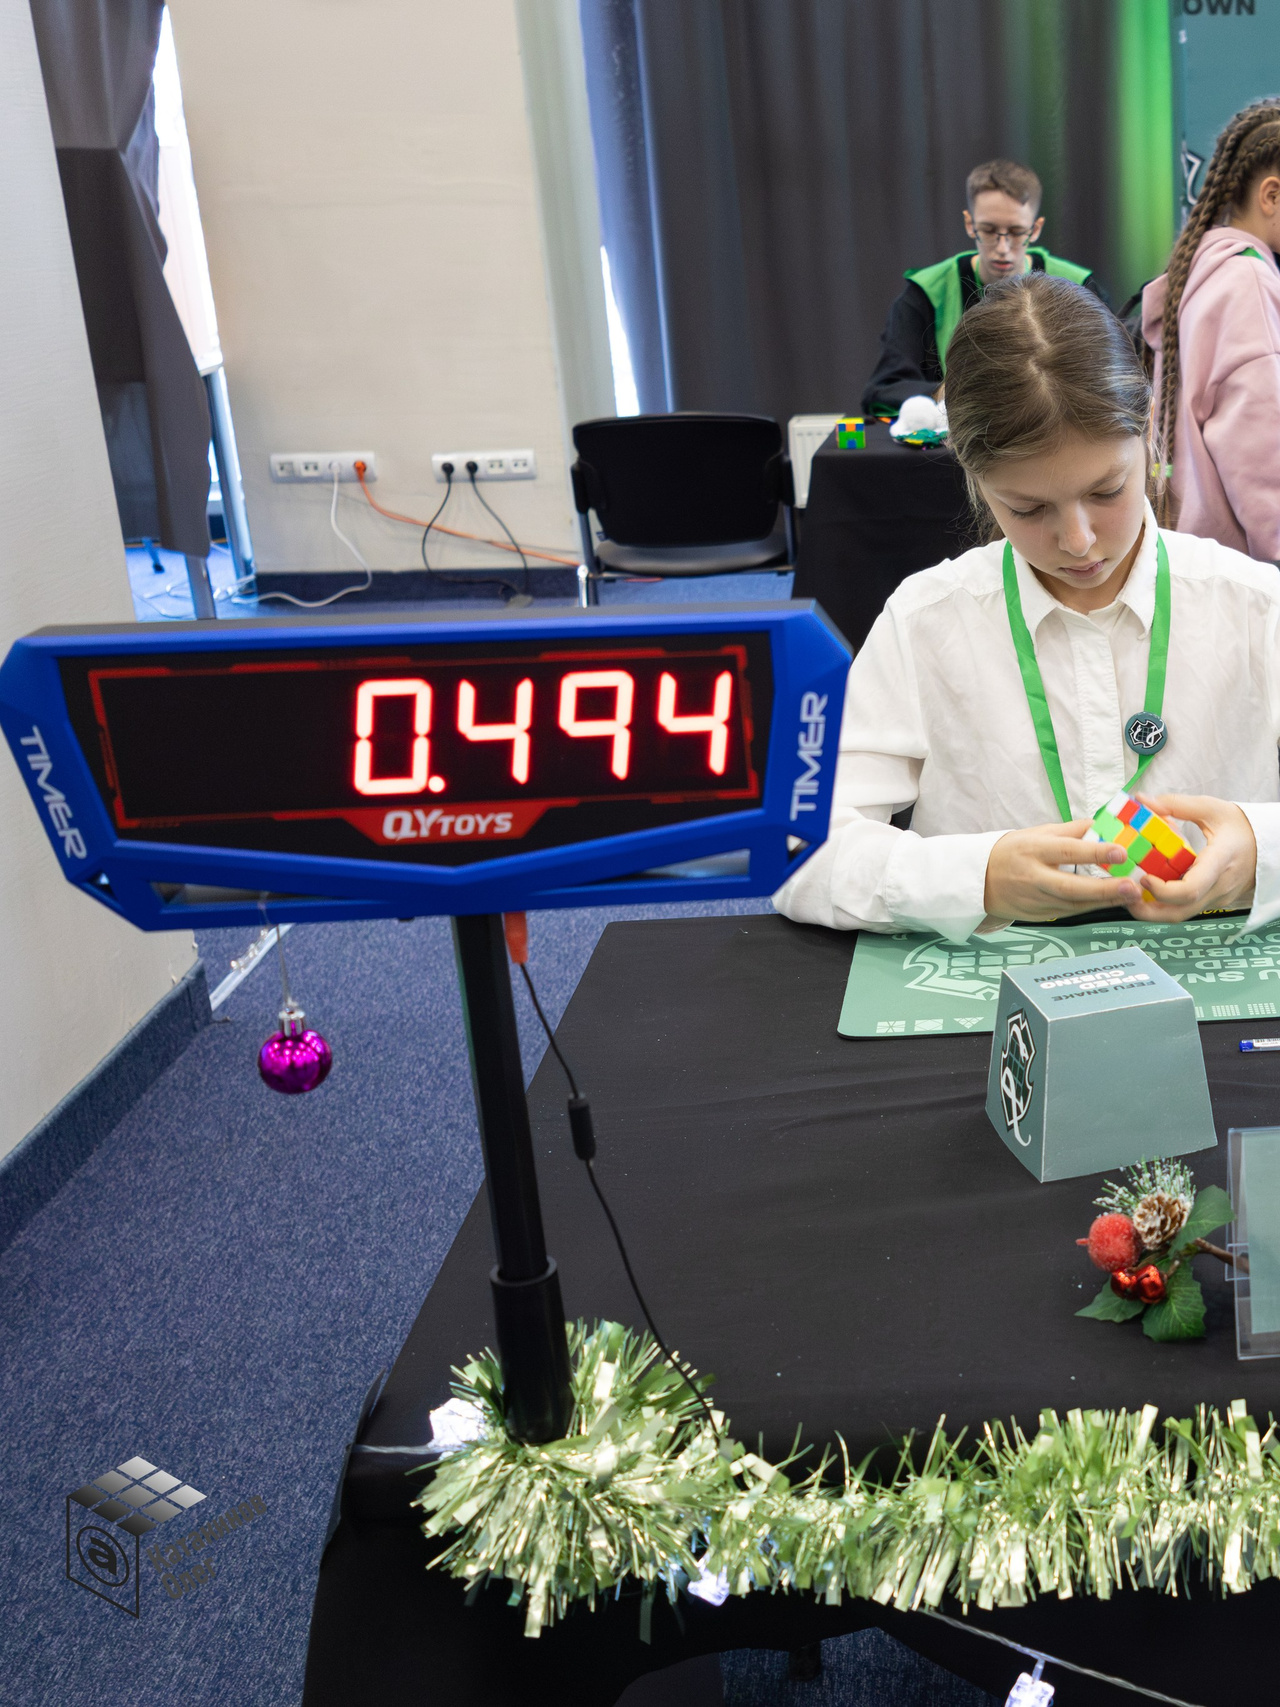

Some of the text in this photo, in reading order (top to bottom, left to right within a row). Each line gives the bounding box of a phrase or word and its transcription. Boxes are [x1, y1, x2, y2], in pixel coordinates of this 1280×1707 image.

[353, 669, 734, 796] 0.494
[790, 690, 829, 823] TIMER
[18, 725, 89, 860] TIMER
[381, 808, 514, 843] QYTOYS
[1034, 961, 1136, 983] SHOWDOWN
[1079, 973, 1150, 990] SPEED
[1051, 980, 1156, 1002] FEFU SNAKE
